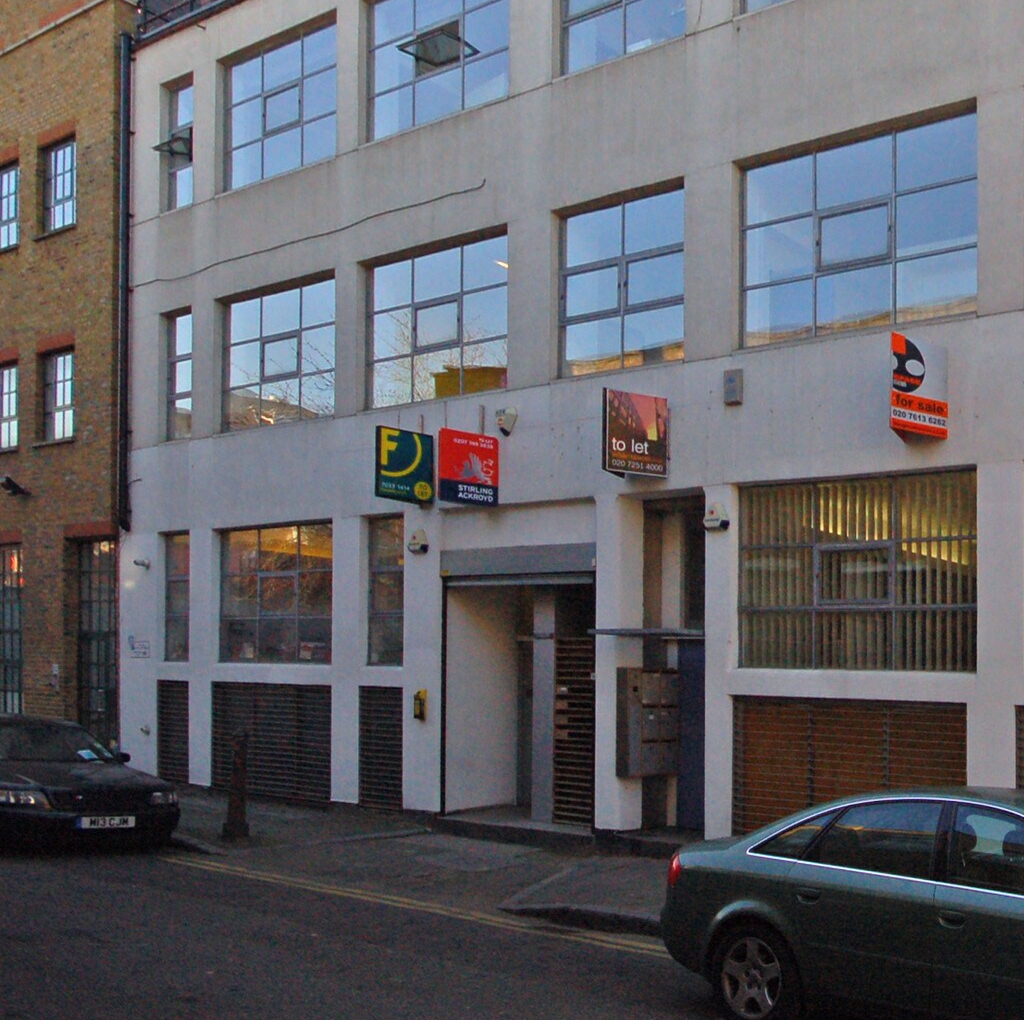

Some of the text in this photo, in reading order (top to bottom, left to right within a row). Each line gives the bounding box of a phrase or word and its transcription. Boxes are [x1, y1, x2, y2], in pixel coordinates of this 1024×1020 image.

[895, 393, 945, 413] for sale
[893, 409, 946, 427] 020 7613 6262
[612, 437, 649, 455] to let
[612, 459, 664, 472] 020 7251 4000
[458, 484, 494, 495] STIRLING
[458, 492, 494, 502] ACKROYD
